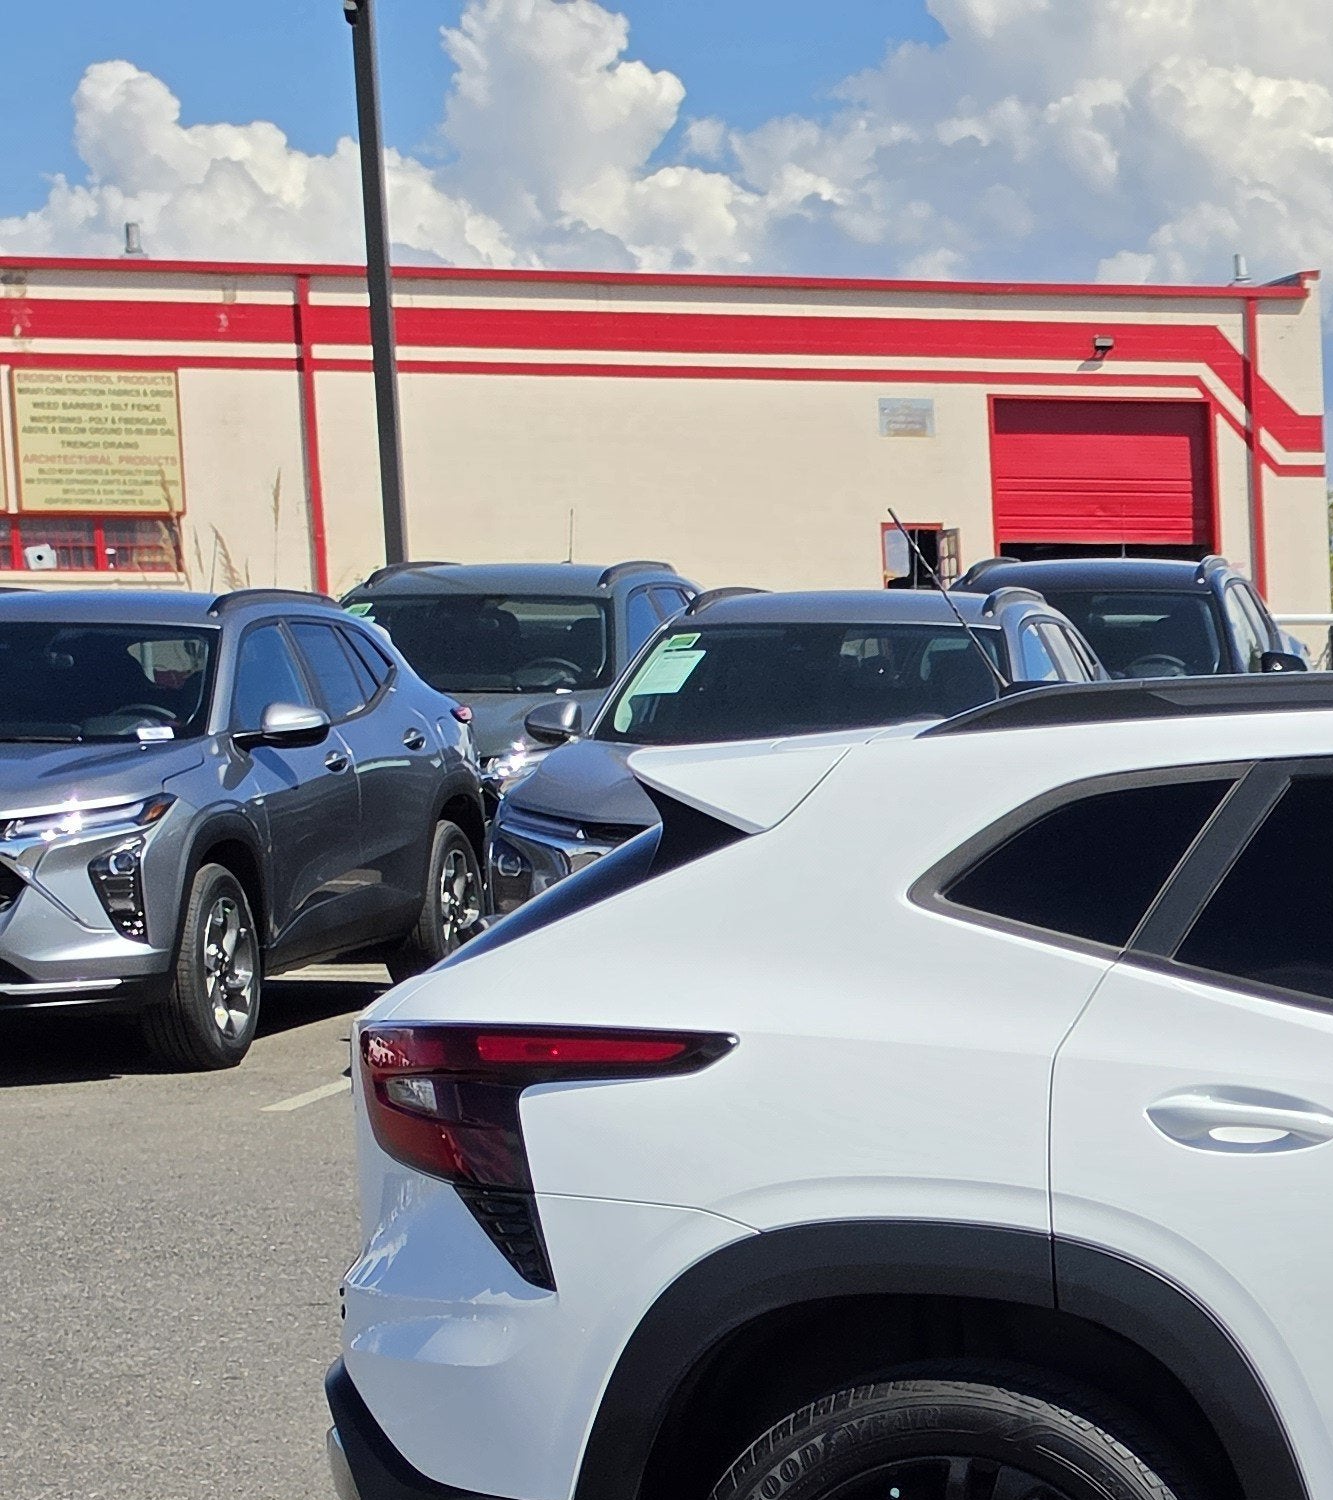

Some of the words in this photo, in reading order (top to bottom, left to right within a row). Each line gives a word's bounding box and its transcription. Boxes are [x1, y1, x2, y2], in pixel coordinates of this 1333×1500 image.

[65, 374, 113, 385] CONTROL
[117, 375, 173, 386] PRODUCTS
[32, 401, 59, 411] WEED
[61, 401, 102, 411] BARRIER
[131, 403, 161, 413] FENCE
[61, 440, 100, 450] TRENCH
[23, 454, 112, 466] ARCHITECTURAL
[118, 455, 177, 467] PRODUCTS
